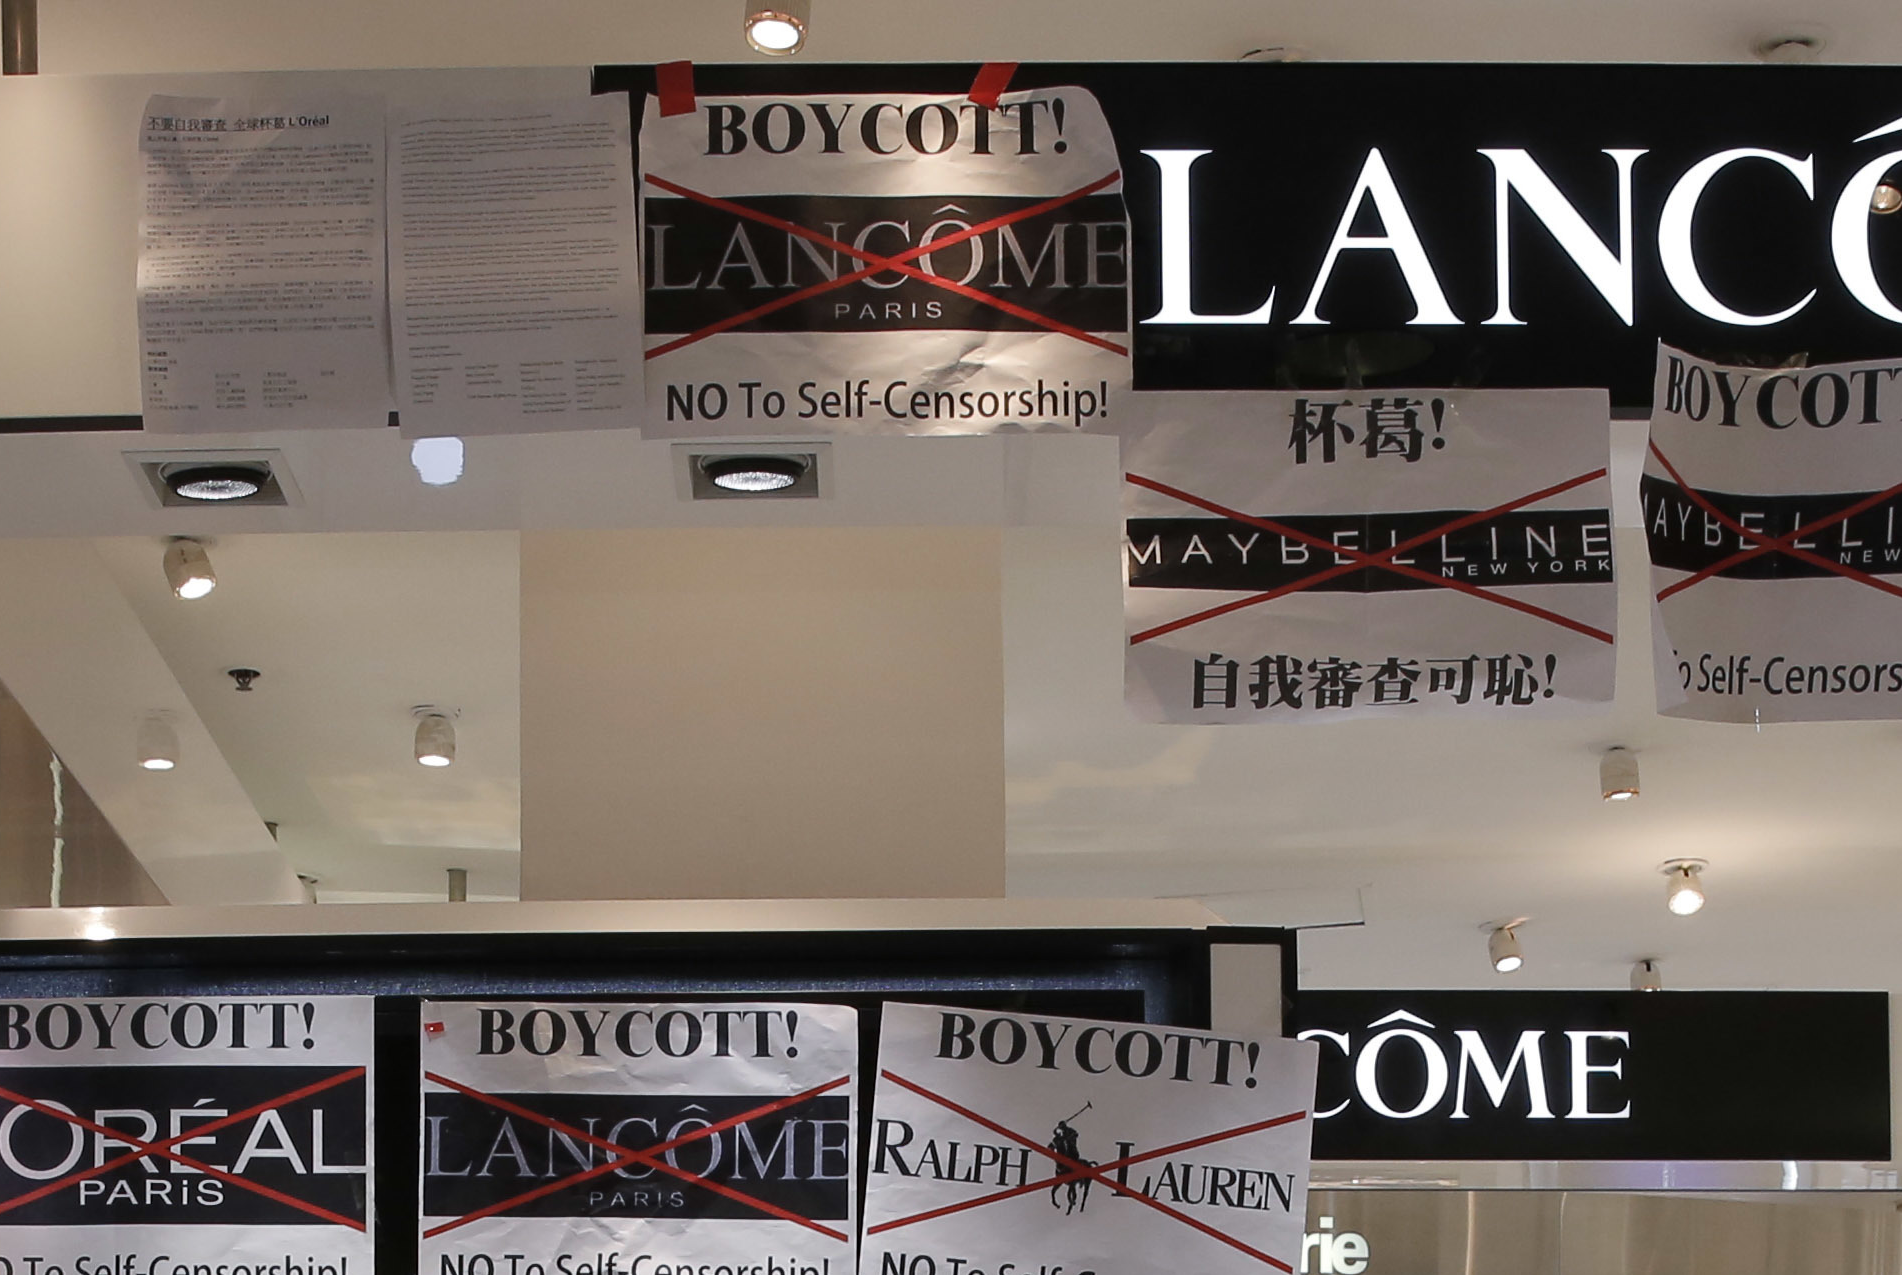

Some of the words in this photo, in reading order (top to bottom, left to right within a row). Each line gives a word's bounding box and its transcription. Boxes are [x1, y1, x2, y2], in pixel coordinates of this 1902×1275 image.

[703, 97, 1068, 156] BOYCOTT!
[646, 203, 1130, 290] LANCÔME
[834, 301, 944, 320] PARIS
[665, 382, 728, 421] NO
[737, 381, 786, 420] To
[797, 379, 1109, 427] Self-Censorship!
[1287, 397, 1447, 464] 杯葛!
[1127, 523, 1610, 567] MAYBELLINE
[1441, 561, 1507, 579] NEW
[1526, 556, 1612, 574] YORK
[1839, 548, 1900, 563] NEW
[477, 1008, 799, 1059] BOYCOTT!
[935, 1011, 1260, 1089] BOYCOTT!
[425, 1104, 850, 1181] LANCÔME
[872, 1118, 1032, 1187] RALPH
[1111, 1142, 1296, 1214] LAUREN
[589, 1190, 685, 1208] PARIS
